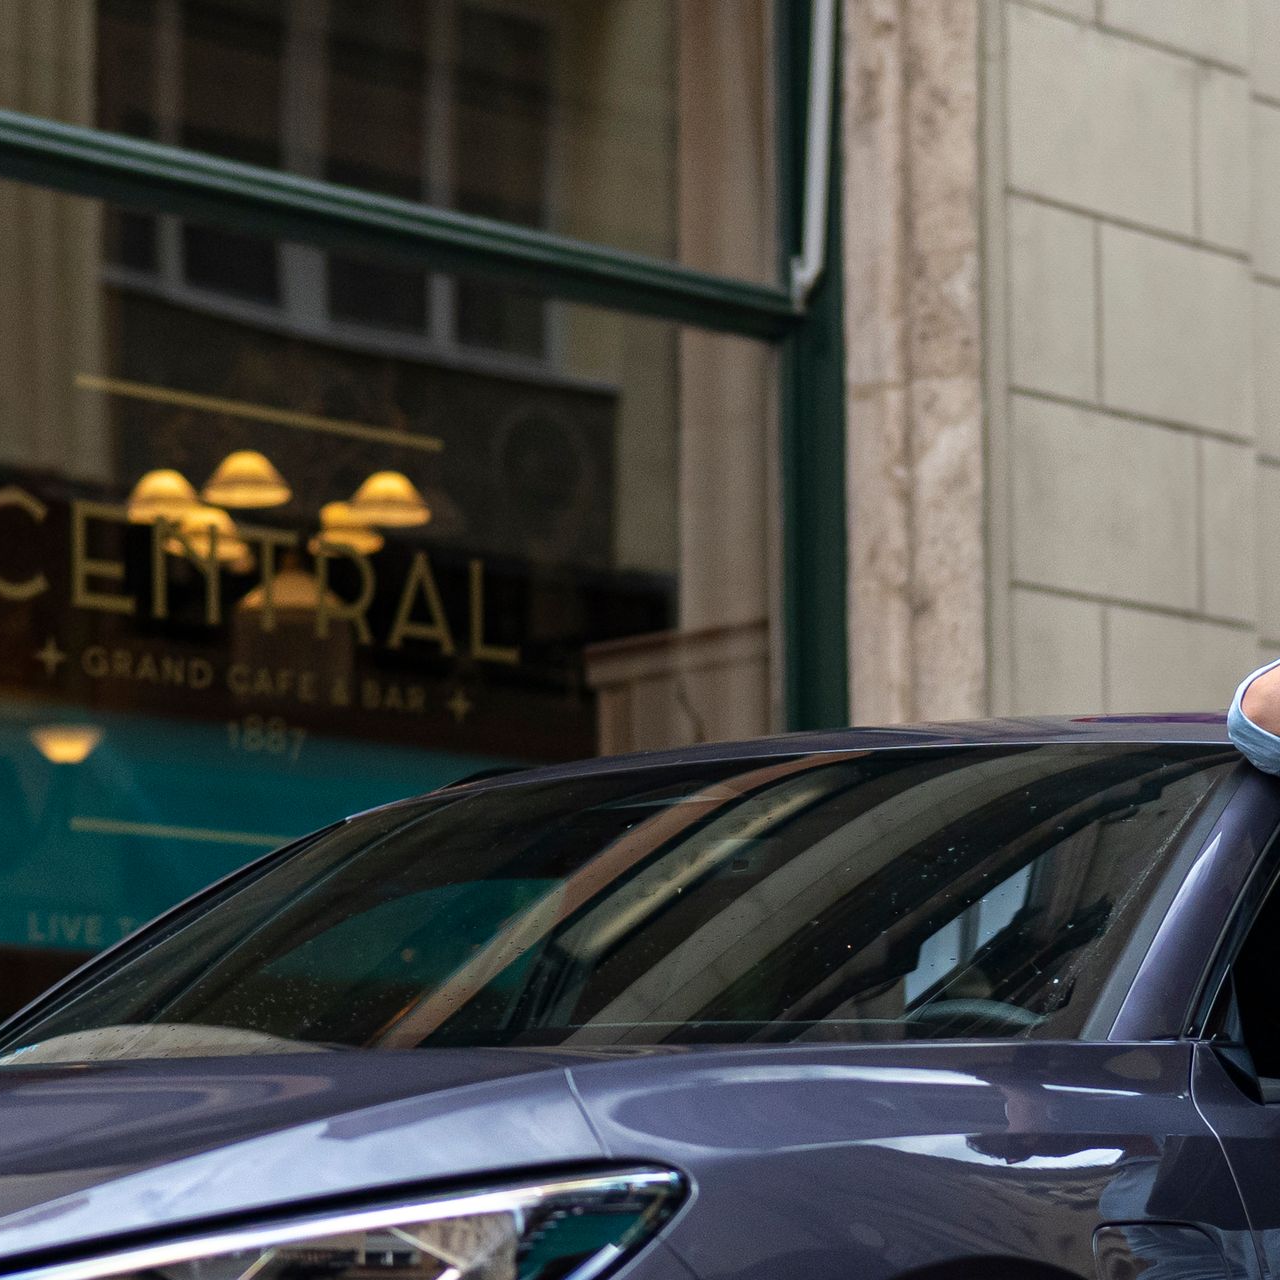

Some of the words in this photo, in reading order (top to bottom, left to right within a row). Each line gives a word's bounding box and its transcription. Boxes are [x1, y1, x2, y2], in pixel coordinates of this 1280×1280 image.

[81, 645, 214, 689] GRAND
[361, 678, 427, 713] BAR
[227, 713, 308, 764] 1887
[27, 911, 104, 945] LIVE
